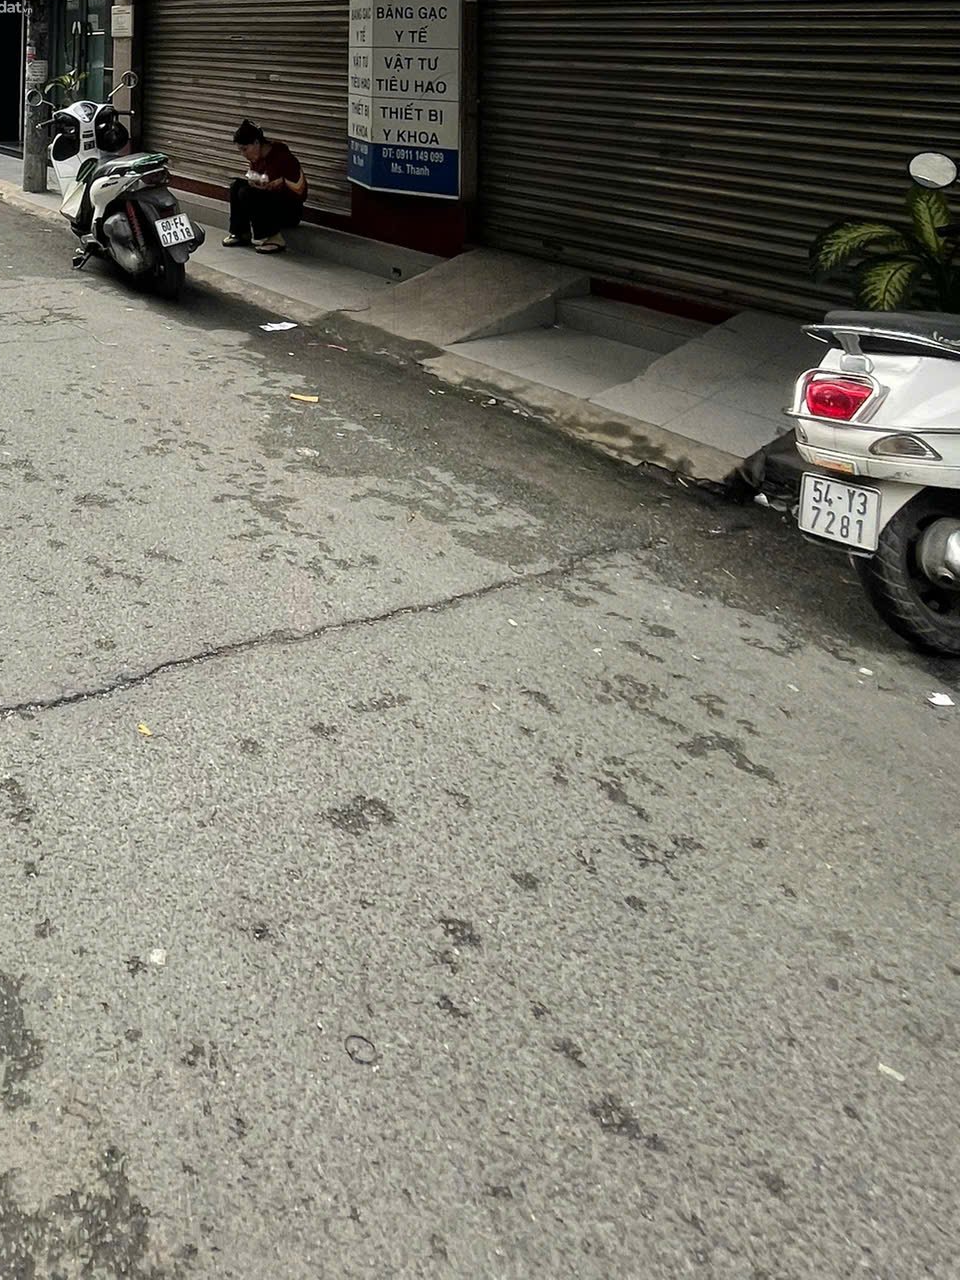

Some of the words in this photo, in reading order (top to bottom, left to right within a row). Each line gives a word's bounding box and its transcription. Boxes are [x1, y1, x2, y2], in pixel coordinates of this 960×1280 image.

[376, 4, 414, 20] BĂNG
[418, 7, 448, 22] GẠC
[394, 30, 403, 43] Y
[408, 25, 428, 43] TẾ
[384, 53, 414, 73] VẬT
[418, 56, 439, 71] TƯ
[376, 76, 409, 92] TIÊU
[414, 81, 447, 94] HAO
[380, 102, 423, 122] THIẾT
[428, 109, 443, 125] BỊ
[383, 129, 391, 141] Y
[397, 130, 439, 145] KHOA
[396, 149, 413, 161] 0911
[391, 162, 405, 174] Ms.
[406, 164, 430, 176] Thanh
[813, 480, 868, 515] 54-Y3
[811, 506, 863, 543] 7281
